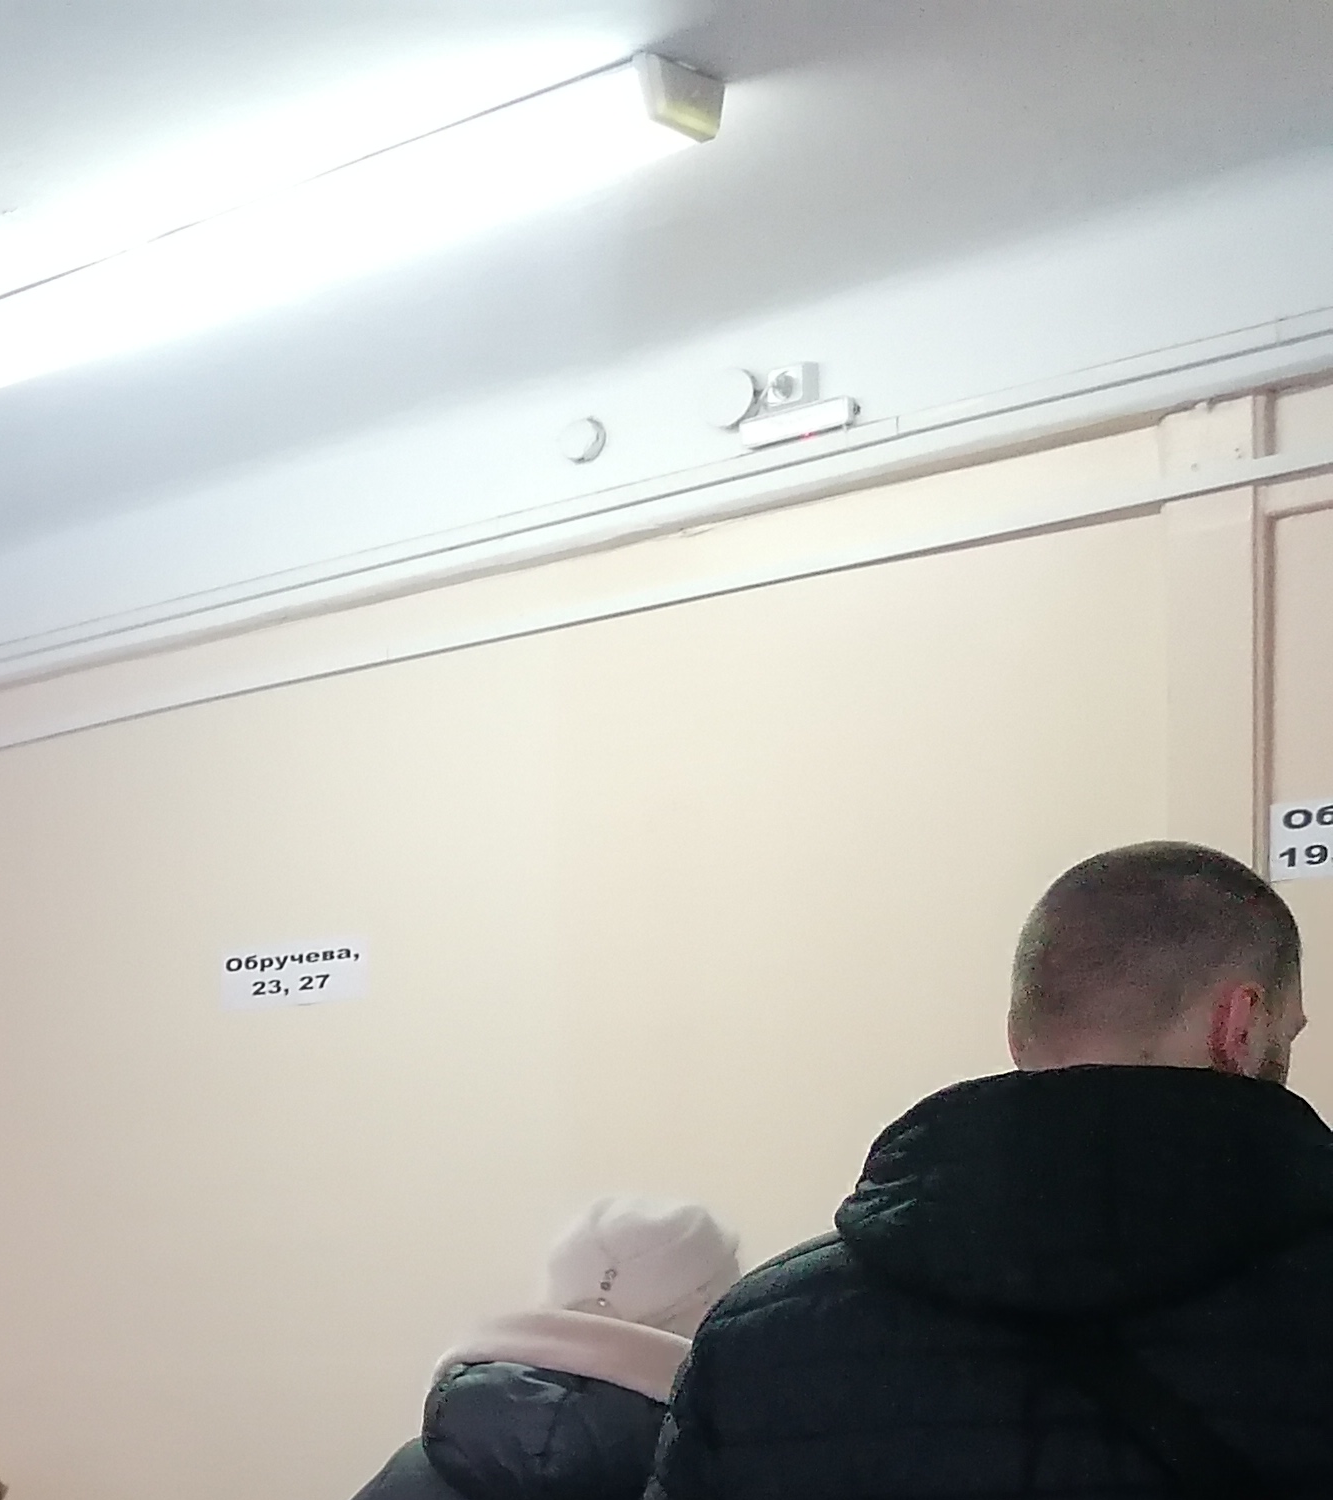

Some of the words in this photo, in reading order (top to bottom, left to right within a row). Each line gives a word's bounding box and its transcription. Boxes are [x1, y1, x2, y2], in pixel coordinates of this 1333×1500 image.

[225, 947, 360, 972] Обручева,
[251, 980, 290, 996] 23,
[298, 974, 331, 991] 27
